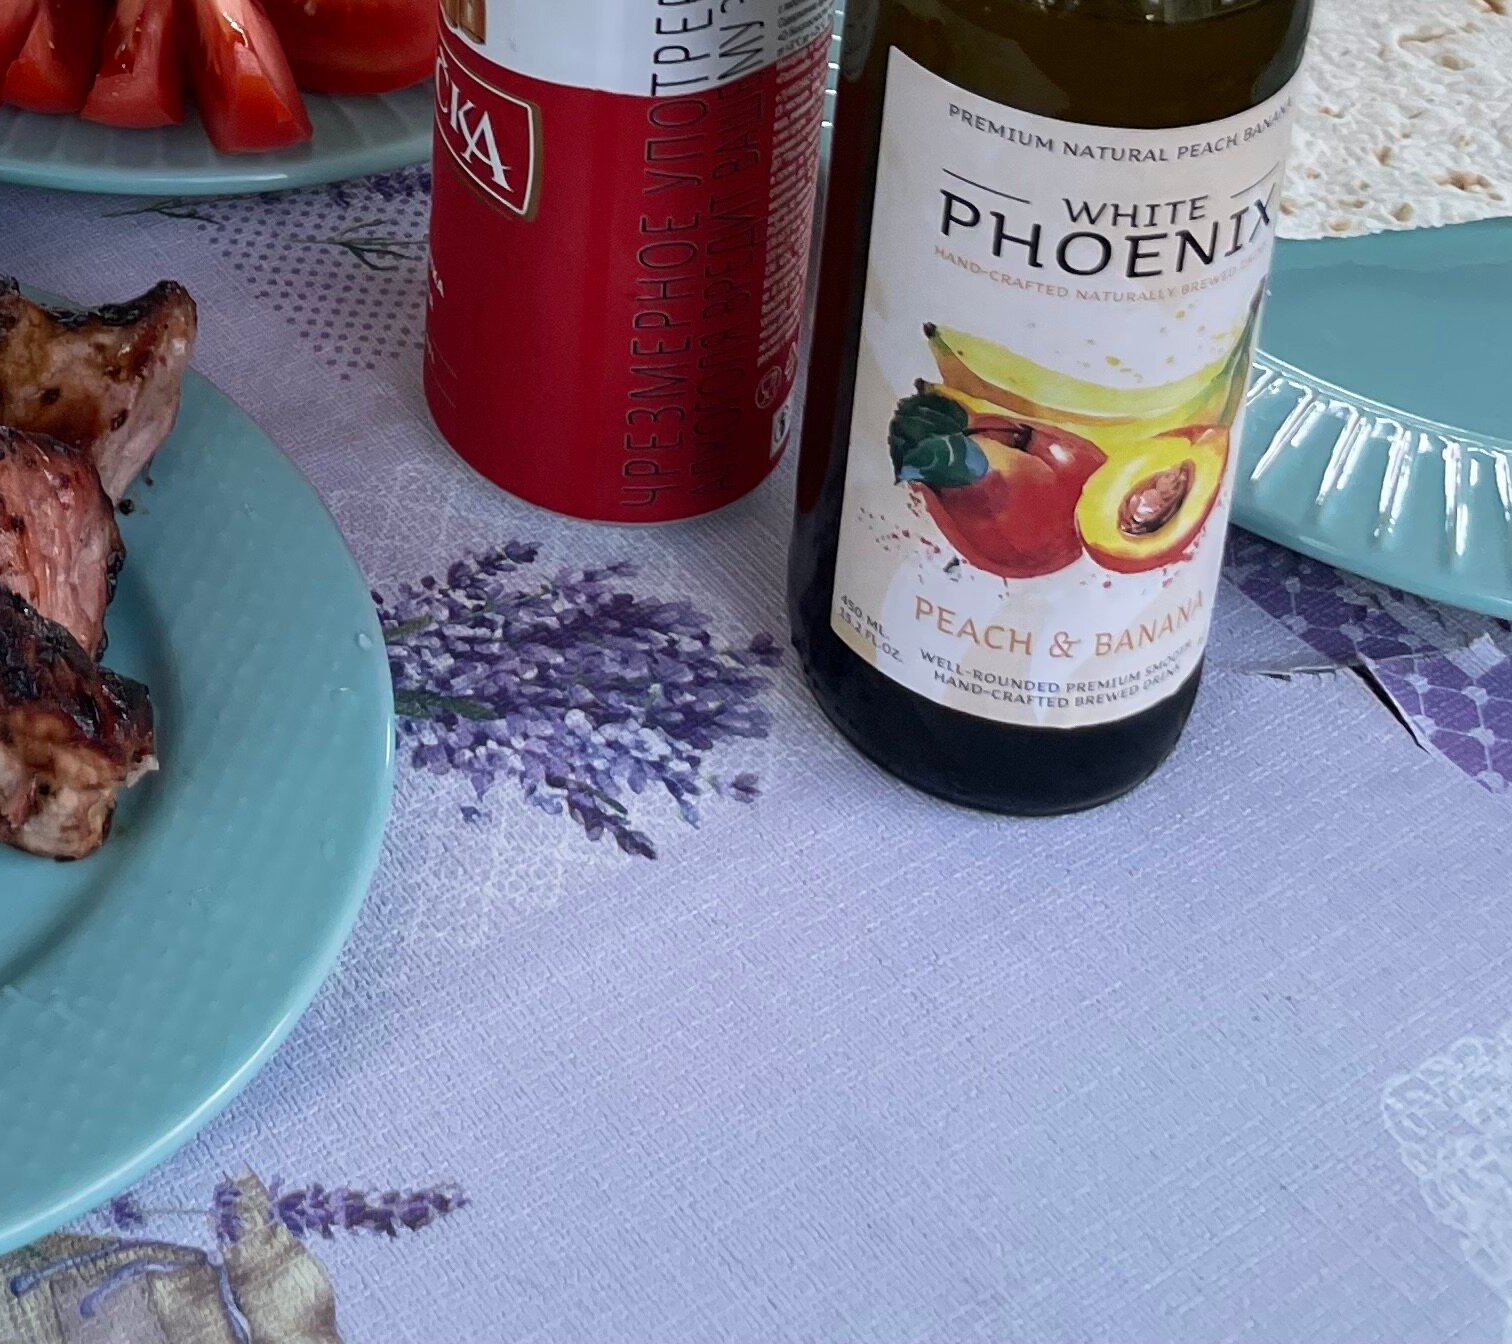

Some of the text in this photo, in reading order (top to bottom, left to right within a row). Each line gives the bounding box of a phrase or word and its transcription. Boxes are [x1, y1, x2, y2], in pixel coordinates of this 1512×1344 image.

[949, 102, 1053, 152] PREMIUM
[1063, 141, 1168, 162] NATURAL
[1177, 133, 1238, 160] PEACH
[938, 182, 1275, 278] PHOENIX
[1061, 195, 1210, 228] WHITE
[934, 244, 1069, 298] HAND-CRAFTED
[1076, 287, 1178, 303] NATURALLY
[621, 209, 700, 506] ЧРЕЗМЕРНОЕ
[915, 589, 1204, 658] PEACH & BANANA
[920, 648, 1060, 693] WELL-ROUNDED
[1066, 670, 1141, 693] PREMIUM
[934, 670, 1069, 708] HAND-CRAFTED
[1075, 685, 1139, 708] BREWED
